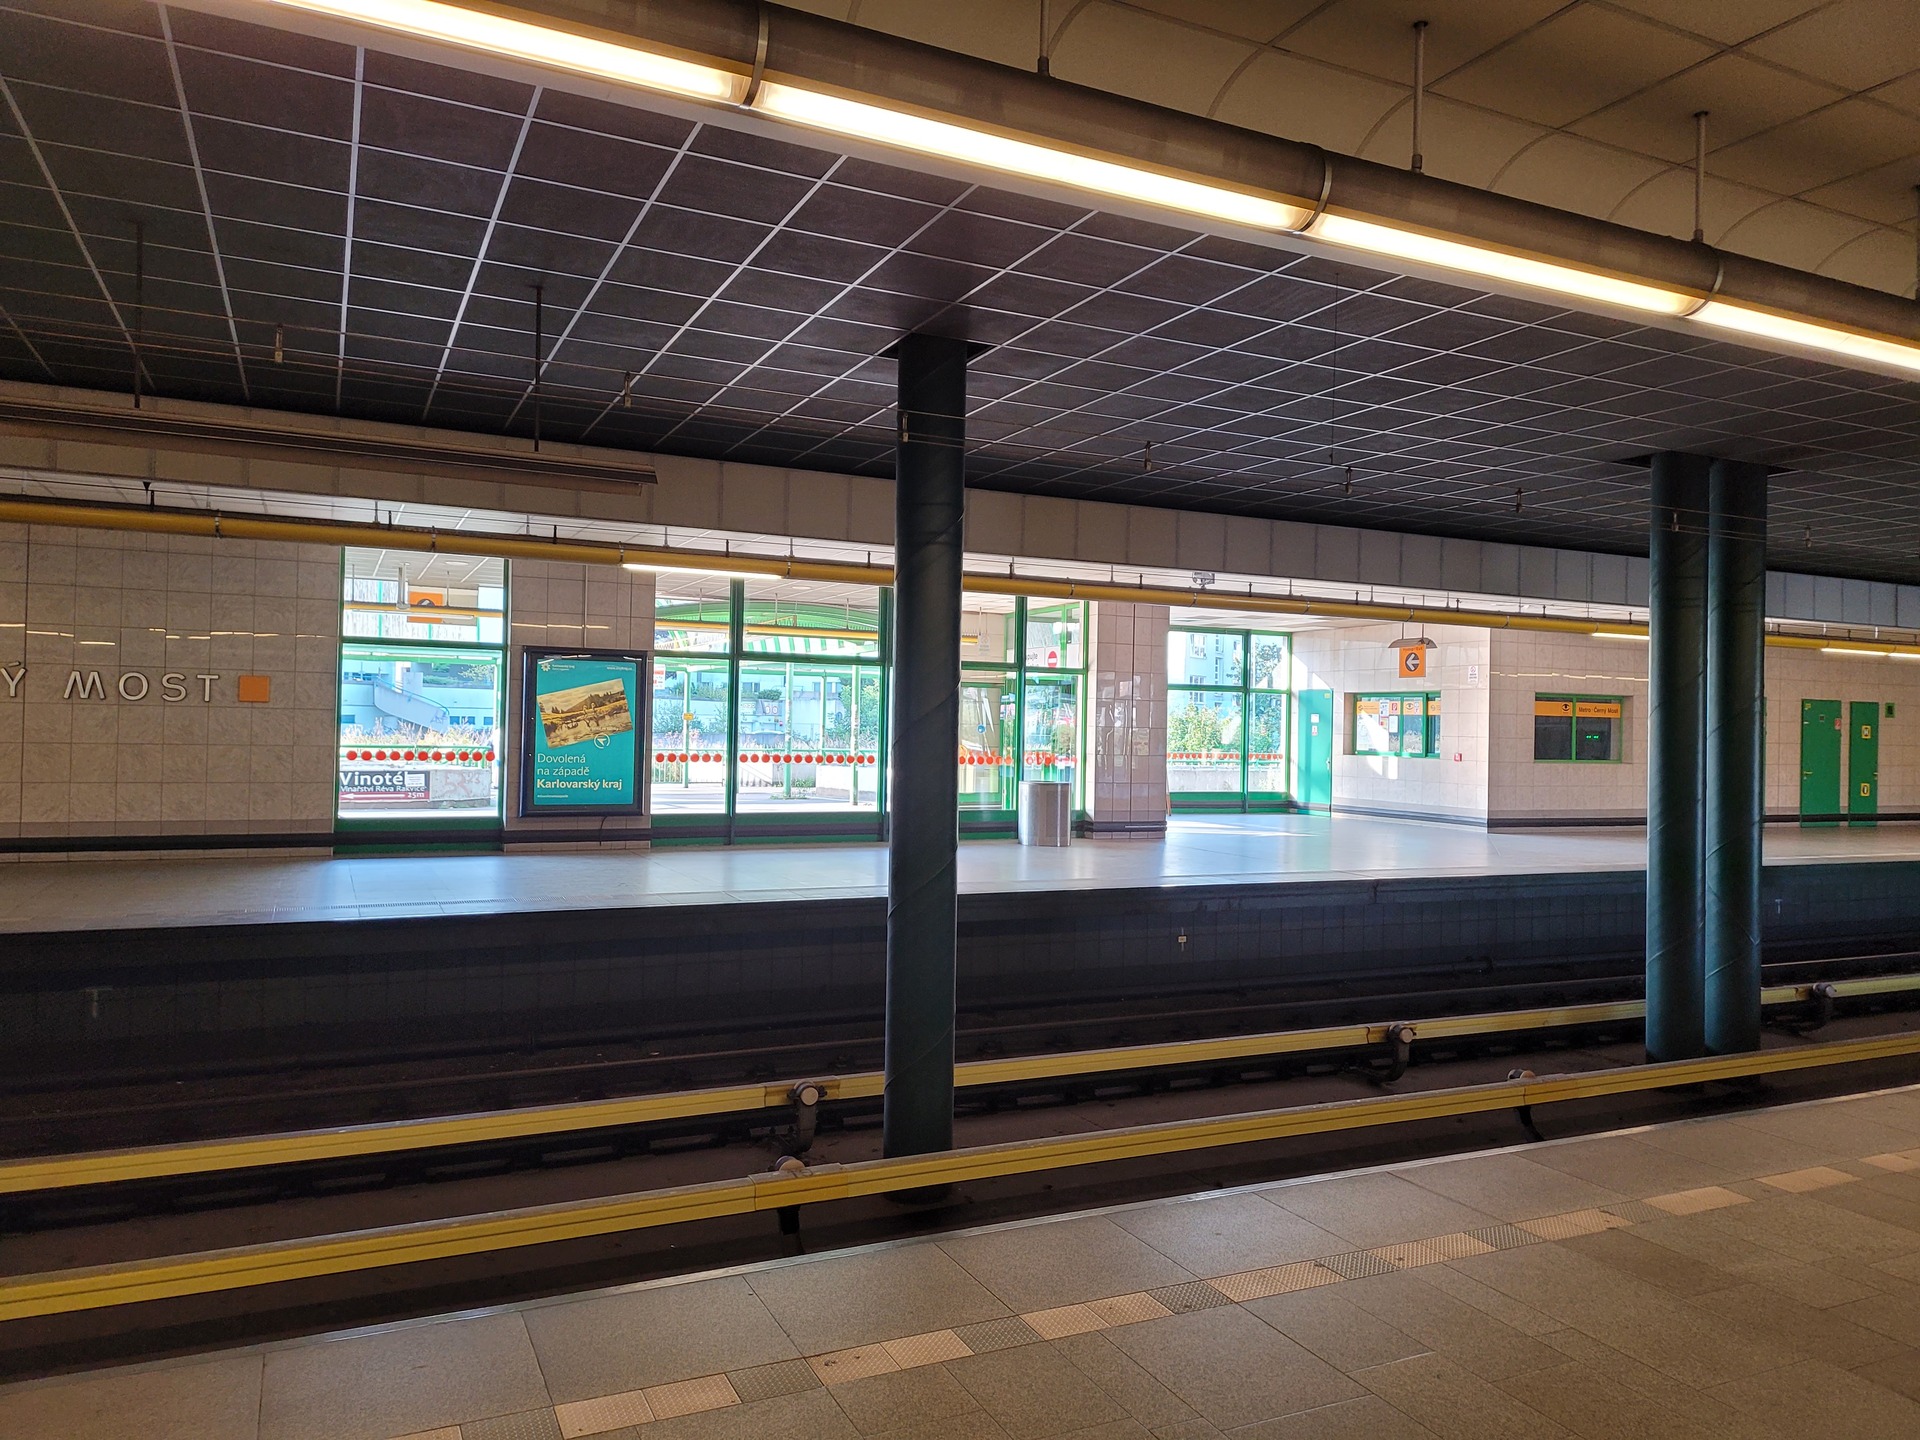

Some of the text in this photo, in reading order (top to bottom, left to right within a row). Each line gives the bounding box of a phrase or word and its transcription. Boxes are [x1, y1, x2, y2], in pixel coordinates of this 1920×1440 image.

[0, 661, 220, 702] Ý MOST
[1594, 706, 1606, 714] Černý
[537, 753, 586, 763] Dovolená
[537, 766, 590, 777] na západě
[537, 779, 622, 791] Karlovarský kraj
